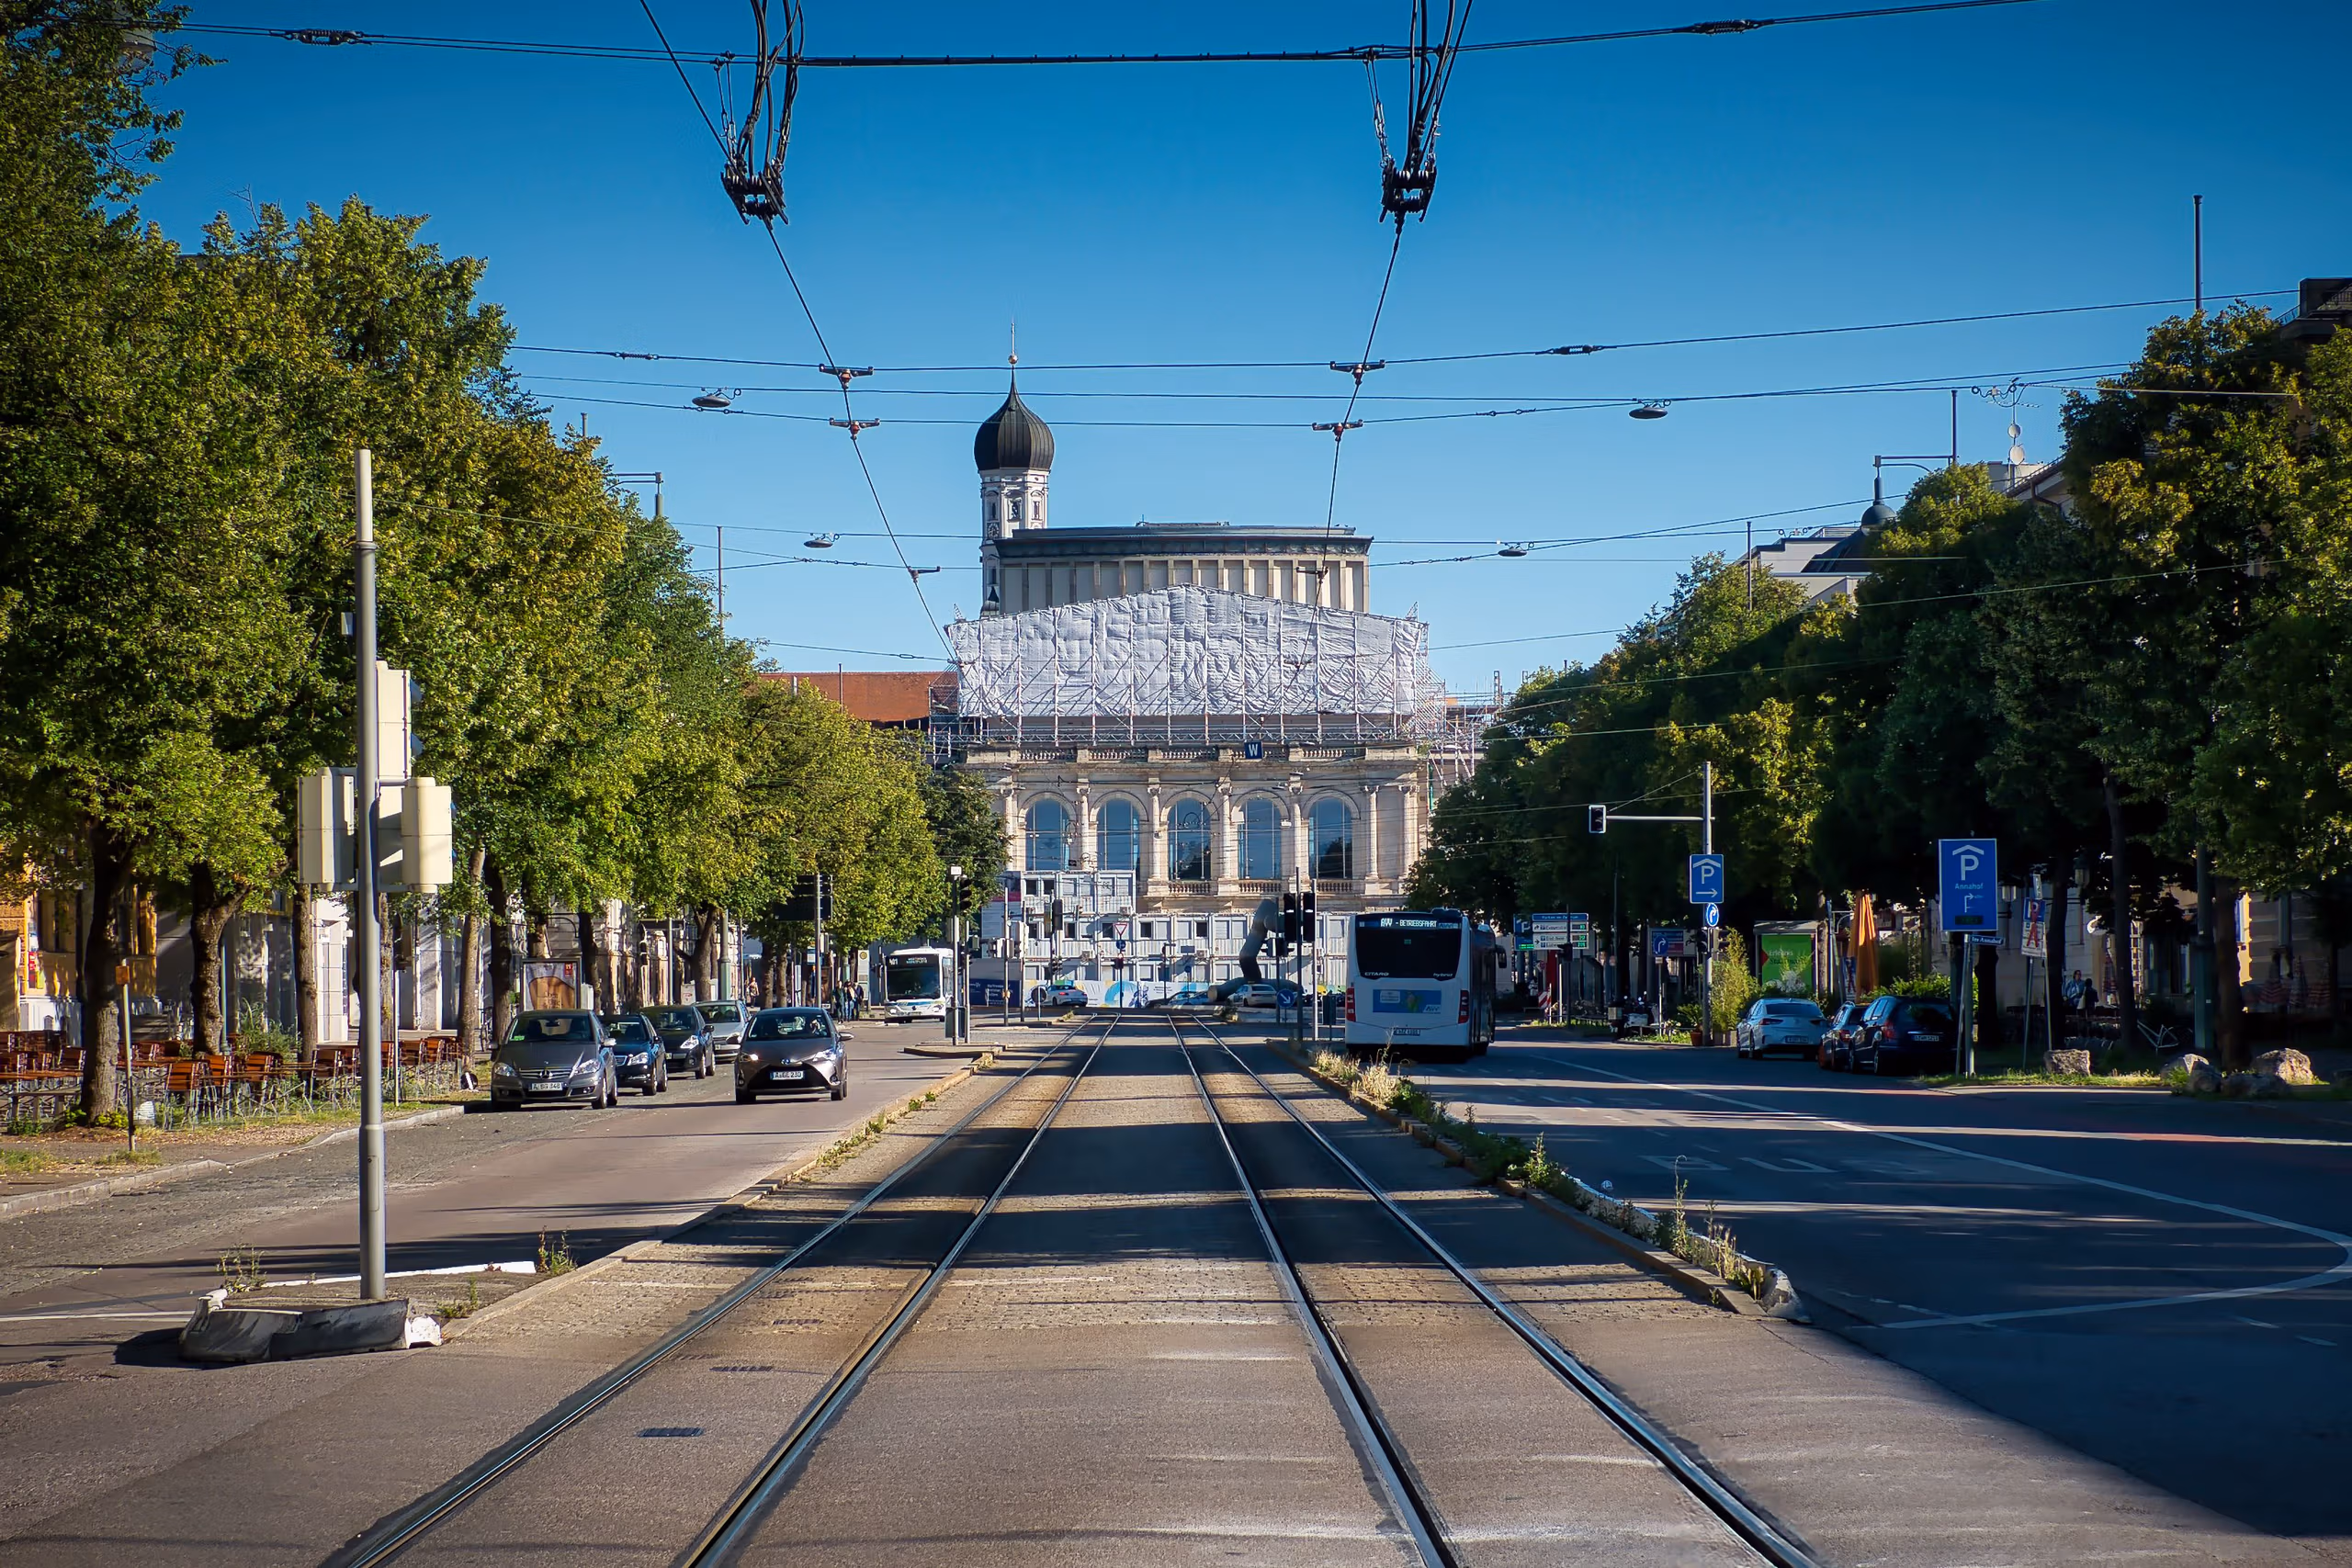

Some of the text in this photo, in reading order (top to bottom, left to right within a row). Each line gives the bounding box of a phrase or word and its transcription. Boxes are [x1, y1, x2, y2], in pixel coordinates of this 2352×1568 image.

[1248, 743, 1259, 757] W
[1960, 854, 1979, 881] P
[1701, 865, 1715, 885] P
[1954, 882, 1984, 890] Annahof
[1380, 918, 1393, 928] AVV
[1399, 919, 1437, 928] BETRIEBSFAHRT
